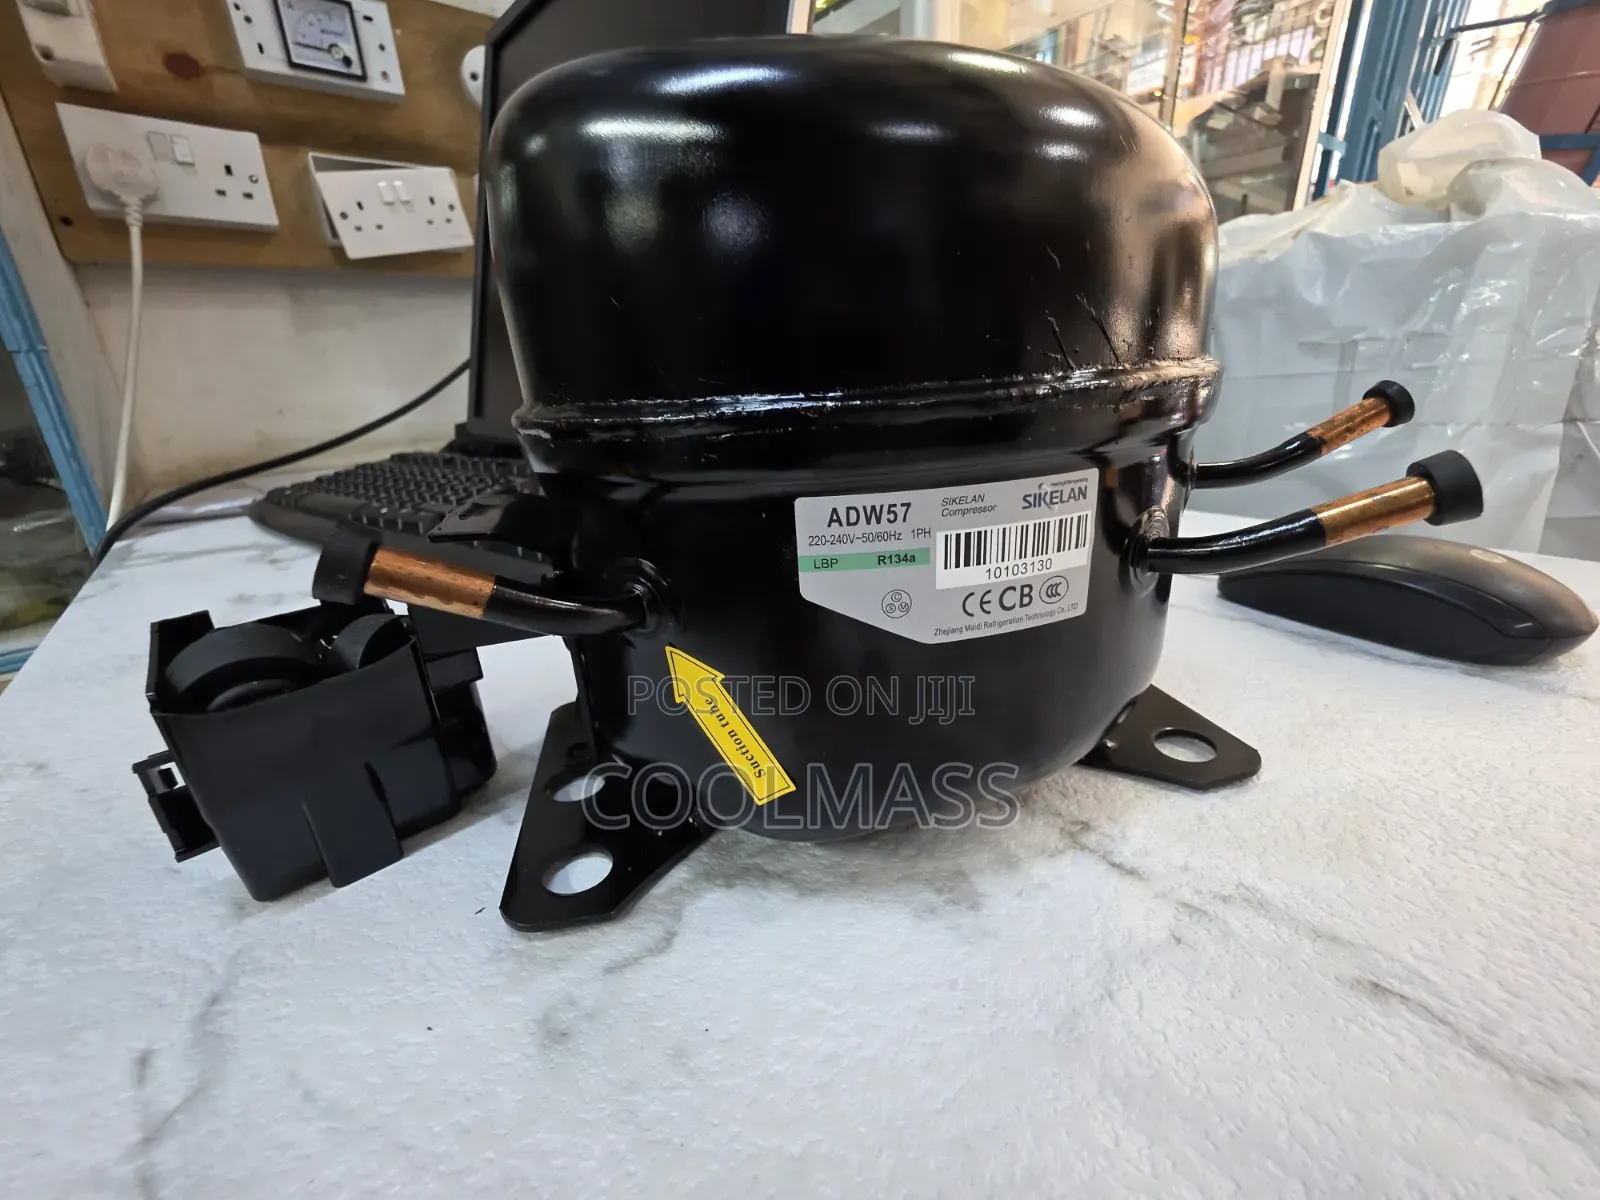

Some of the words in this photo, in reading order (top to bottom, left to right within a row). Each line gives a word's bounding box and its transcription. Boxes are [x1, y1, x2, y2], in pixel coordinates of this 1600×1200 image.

[941, 493, 985, 507] SIKELAN
[1021, 485, 1088, 510] SIKELAN
[826, 502, 912, 528] ADW57
[941, 504, 997, 518] Compressor
[808, 530, 903, 547] 220-240V~50/60Hz
[910, 527, 931, 540] 1PH
[813, 558, 839, 570] LBP
[877, 553, 916, 566] R134a
[985, 557, 1053, 580] 10103130
[998, 583, 1034, 612] CB
[933, 626, 964, 637] Zhejiang
[964, 621, 983, 632] Maidi
[983, 615, 1024, 629] Refrigeration
[1024, 609, 1056, 622] Technology
[705, 697, 730, 729] tube
[727, 728, 767, 779] Suction
